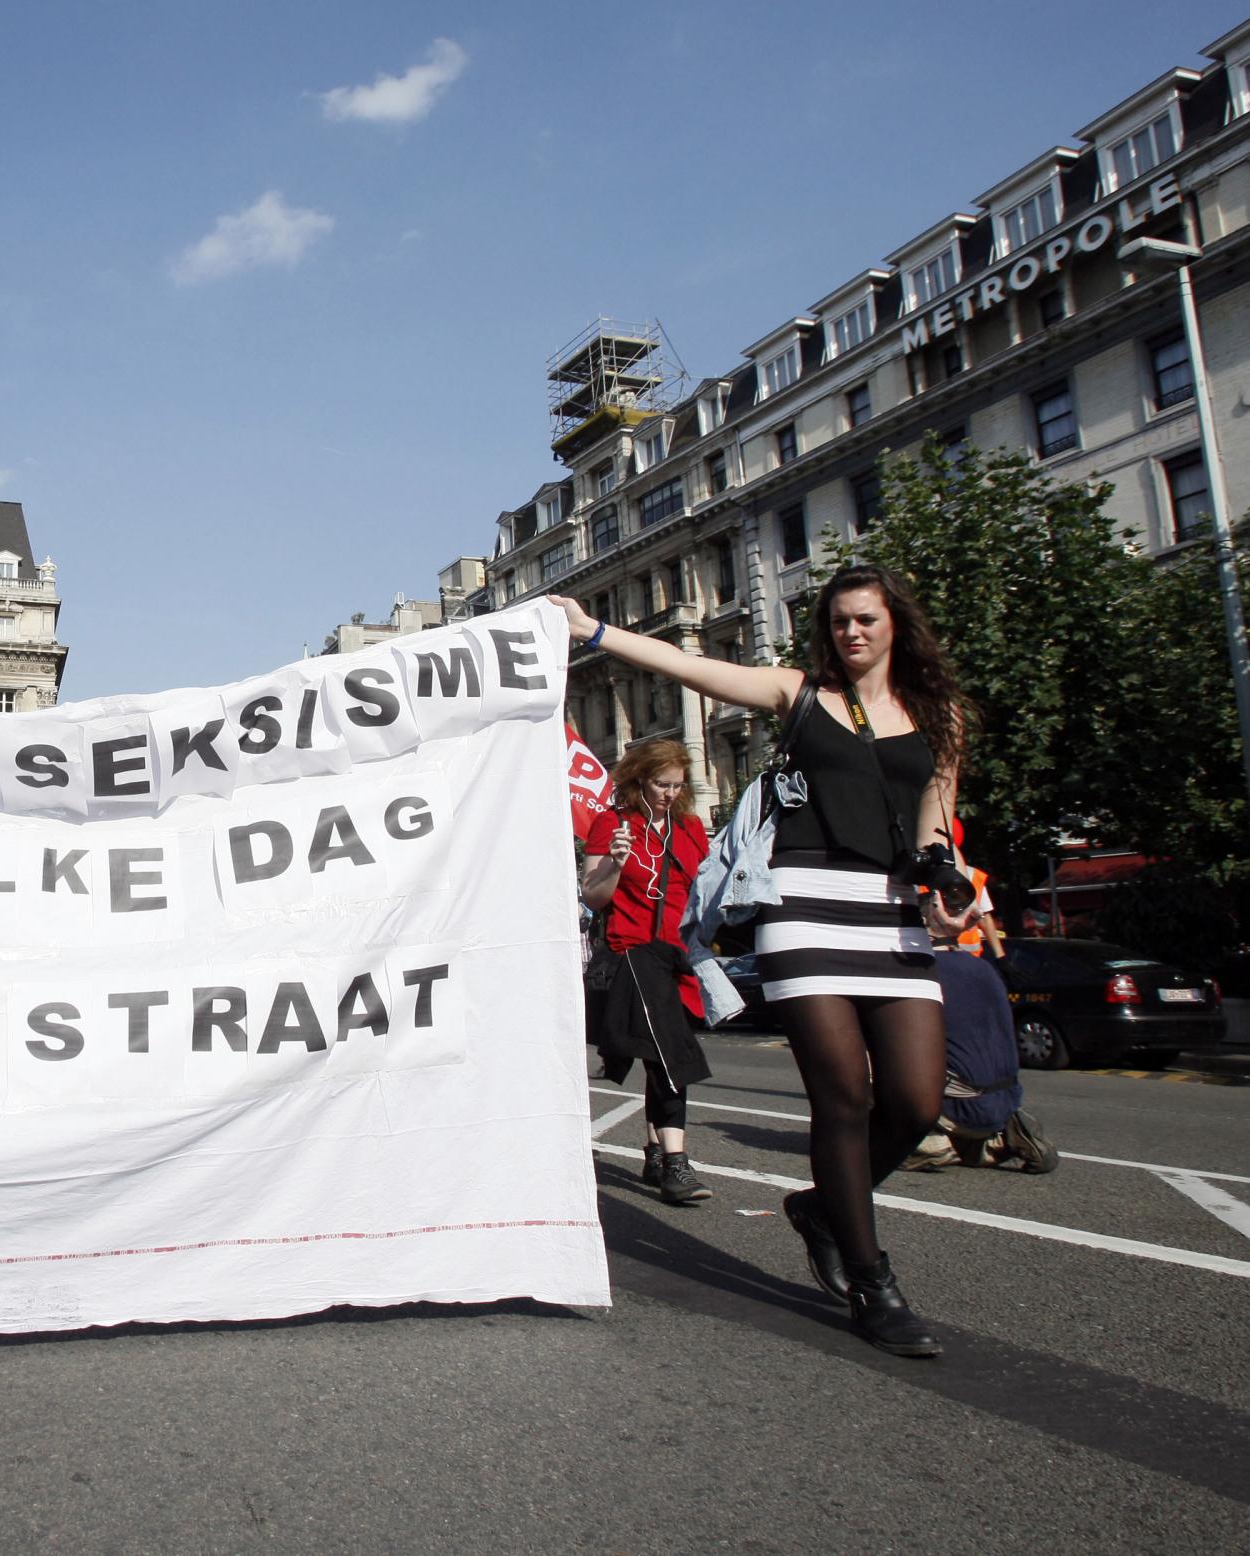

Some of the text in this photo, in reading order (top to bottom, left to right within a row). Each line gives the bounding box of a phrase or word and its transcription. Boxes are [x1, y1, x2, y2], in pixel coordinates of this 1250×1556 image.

[901, 172, 1182, 354] METROPOLE
[14, 629, 548, 797] SEKSISME
[229, 796, 434, 884] DAG
[586, 798, 607, 813] So
[25, 963, 449, 1062] STRAAT
